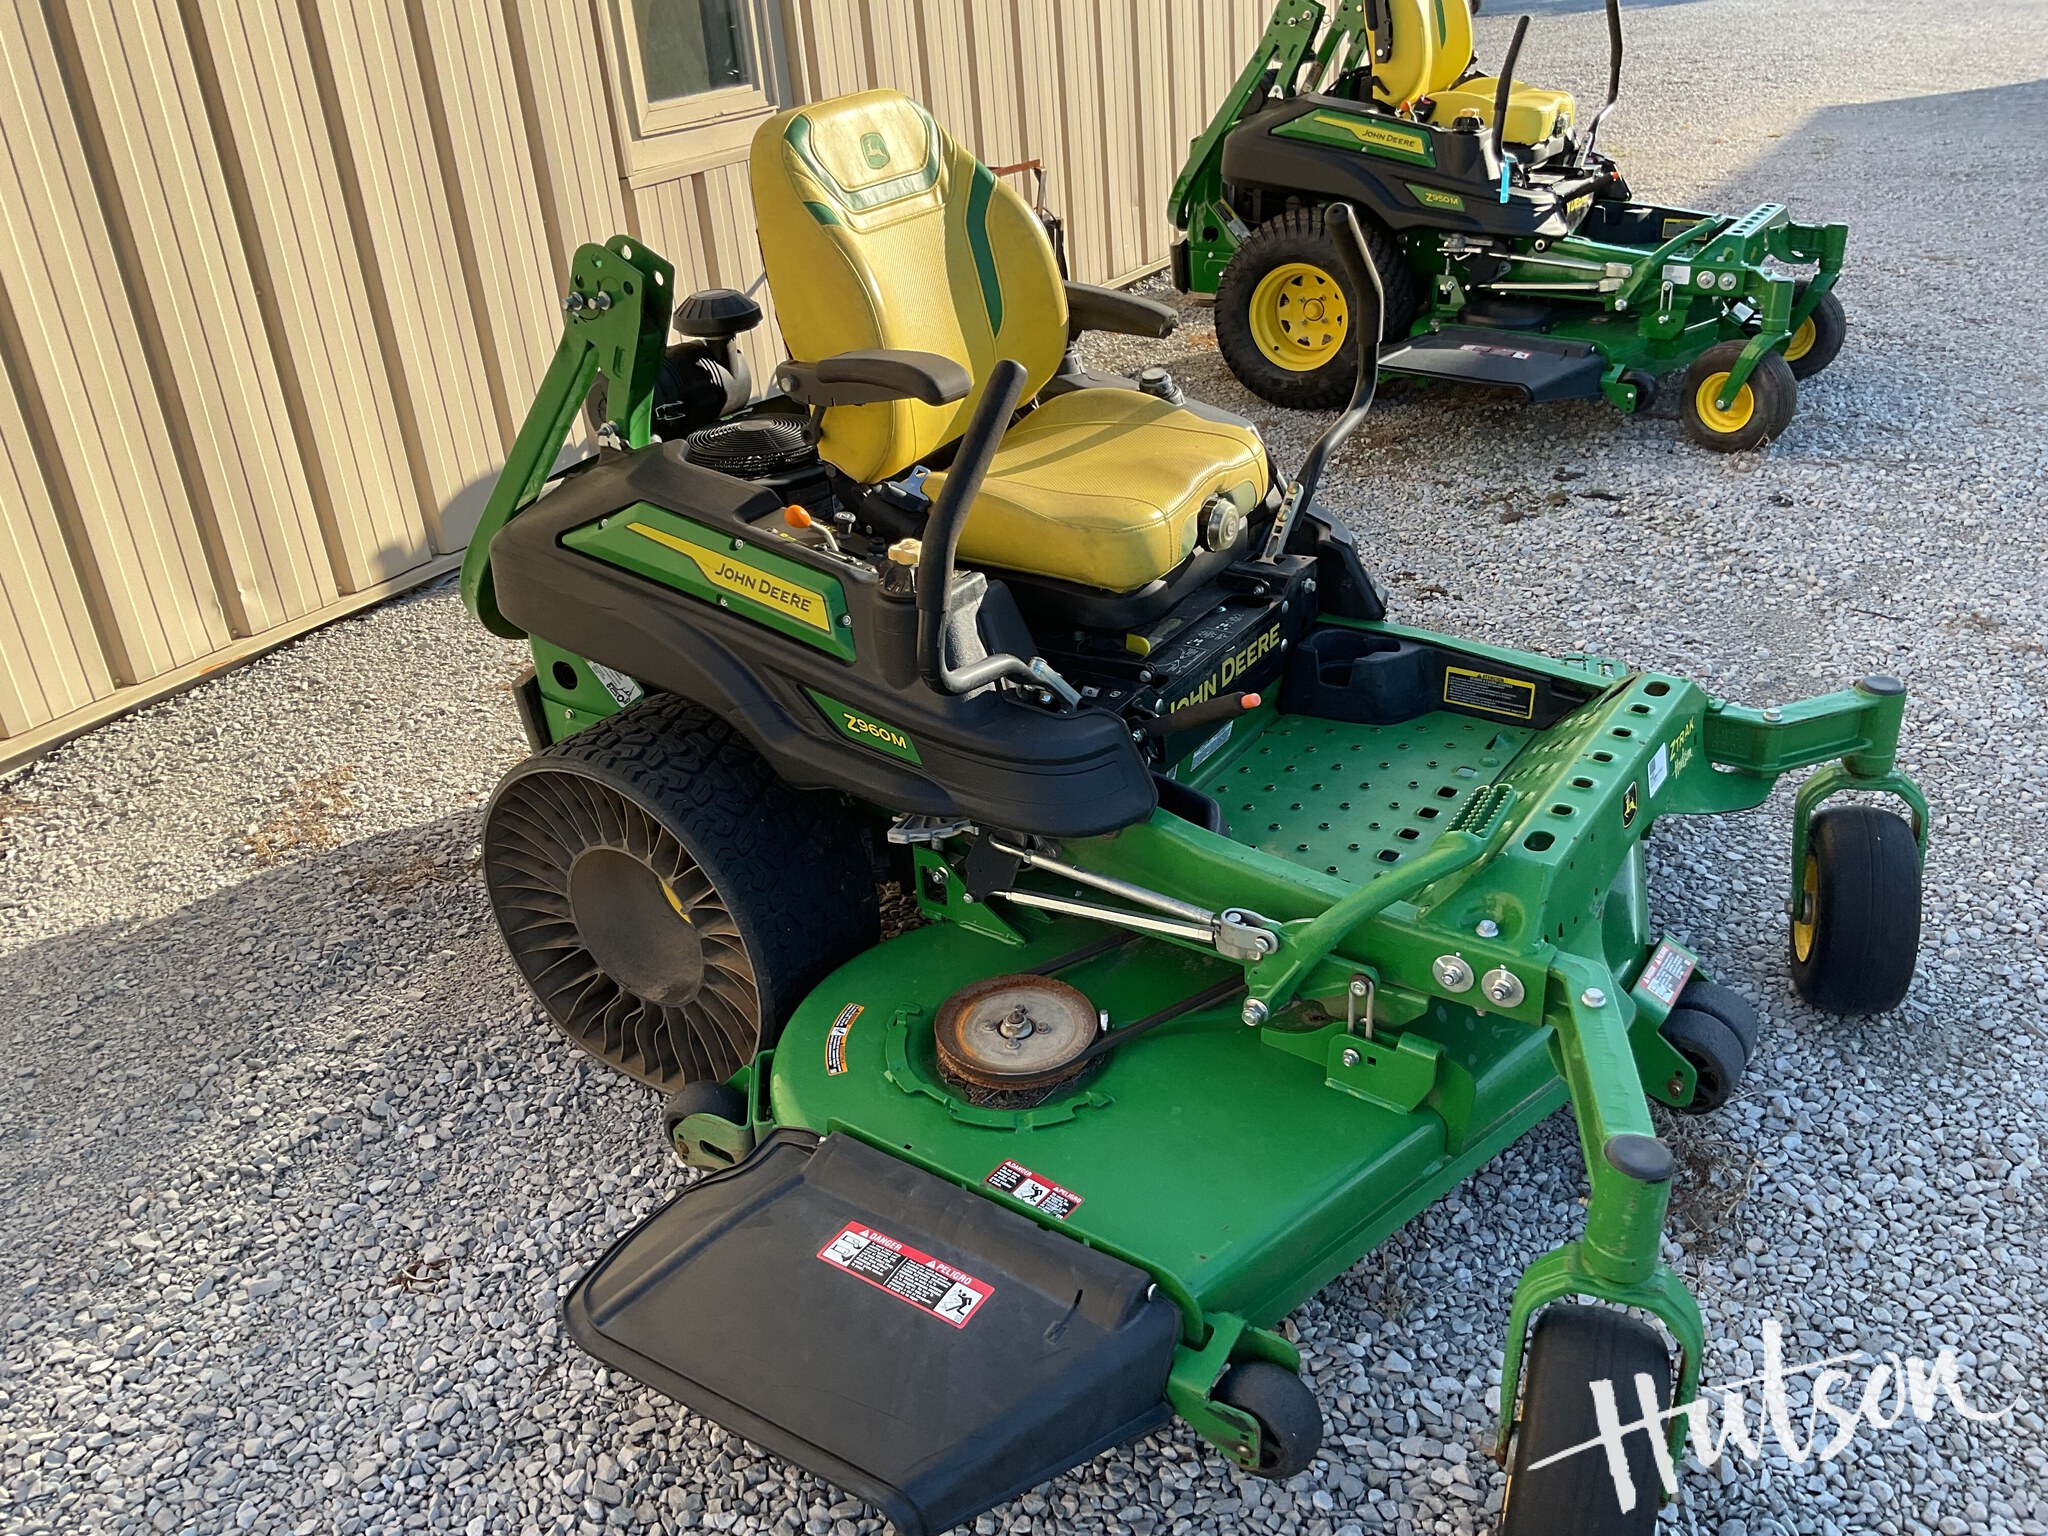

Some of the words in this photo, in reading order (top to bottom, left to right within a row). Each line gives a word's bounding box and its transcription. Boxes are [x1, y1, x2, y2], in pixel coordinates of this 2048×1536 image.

[1362, 130, 1386, 141] JOHN
[1386, 135, 1416, 147] DEERE
[1424, 192, 1459, 205] Z950M
[715, 563, 756, 590] JOHN
[759, 579, 812, 613] DEERE
[1221, 622, 1281, 689] DEERE
[843, 712, 907, 750] Z960M
[1010, 1162, 1033, 1177] DANGER
[1058, 1188, 1082, 1204] PELIGRO
[869, 1232, 903, 1252] DANGER
[936, 1263, 973, 1286] PELIGRO
